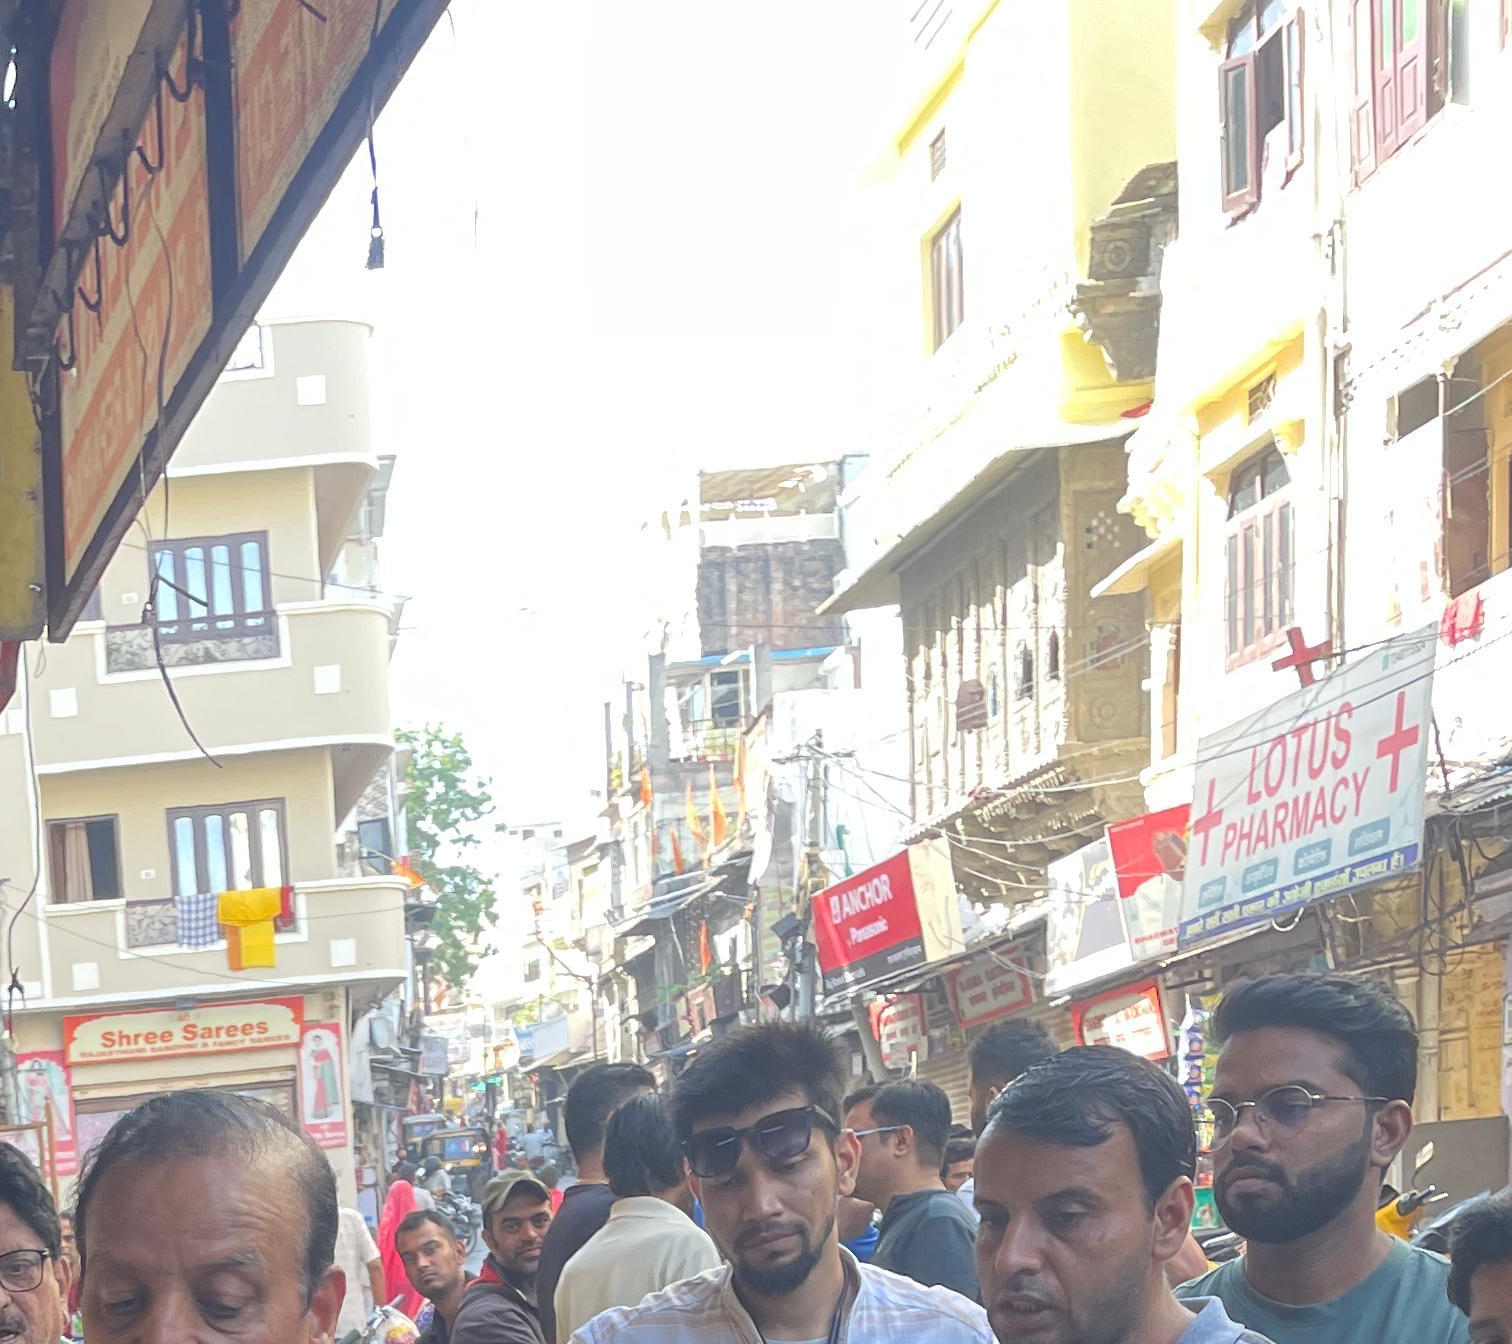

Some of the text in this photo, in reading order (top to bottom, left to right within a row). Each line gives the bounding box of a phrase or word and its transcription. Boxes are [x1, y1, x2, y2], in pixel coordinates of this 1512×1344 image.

[1246, 701, 1353, 806] LOTUS
[1220, 766, 1371, 867] PHARMACY
[842, 873, 893, 919] ANCHOR
[101, 1021, 269, 1049] Shree Sarees
